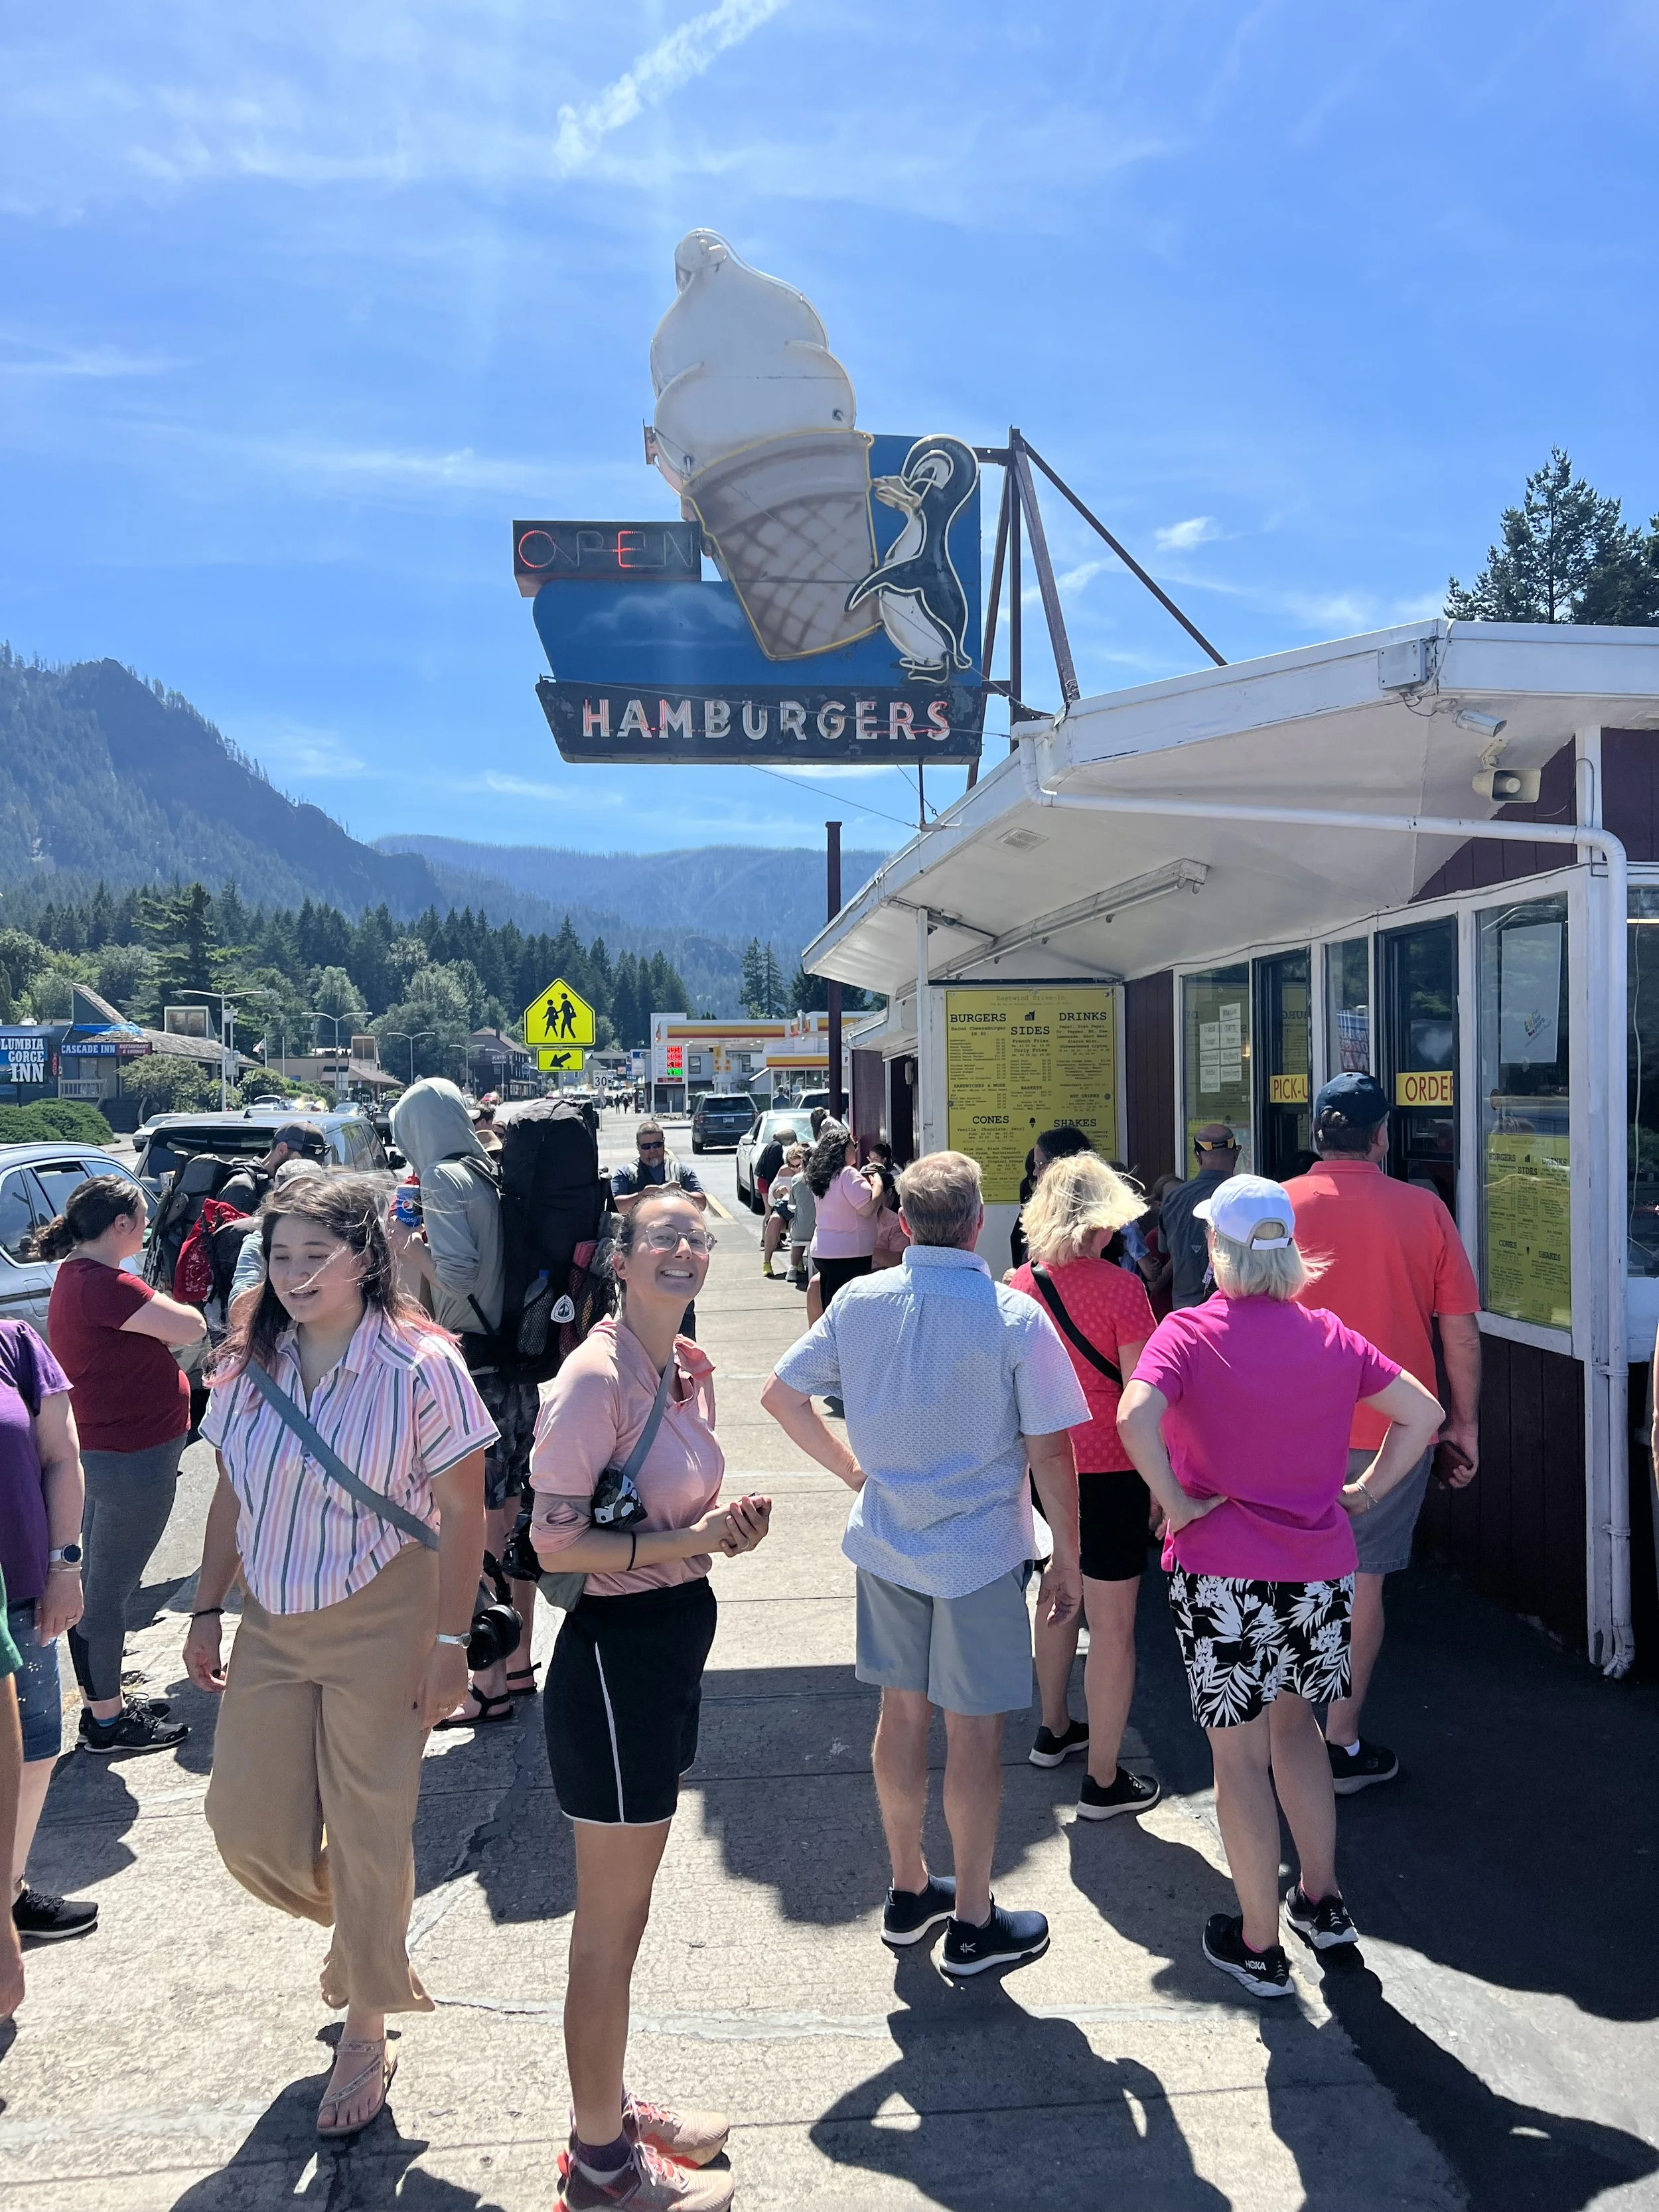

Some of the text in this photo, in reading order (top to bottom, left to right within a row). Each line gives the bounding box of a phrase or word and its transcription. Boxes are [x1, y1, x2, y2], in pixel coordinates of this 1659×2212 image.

[518, 530, 693, 568] OPEN
[583, 699, 950, 741] HAMBURGERS
[950, 1013, 1007, 1023] BURGERS
[1059, 1012, 1107, 1021] DRINKS
[1011, 1026, 1050, 1035] SIDES
[0, 1038, 44, 1051] LUMBIA
[61, 1044, 115, 1054] CASCADE INN
[8, 1051, 44, 1063] GORGE
[10, 1063, 44, 1082] INN
[595, 1076, 607, 1086] 30
[972, 1116, 1009, 1124] CONES
[1054, 1118, 1097, 1128] SHAKES
[1488, 1153, 1516, 1162] BURGERS
[1542, 1157, 1568, 1166] DRINKS
[1518, 1167, 1538, 1175] SIDES
[1498, 1239, 1517, 1249] CONES
[1538, 1250, 1561, 1261] SHAKES
[1245, 1960, 1267, 1971] HOKA
